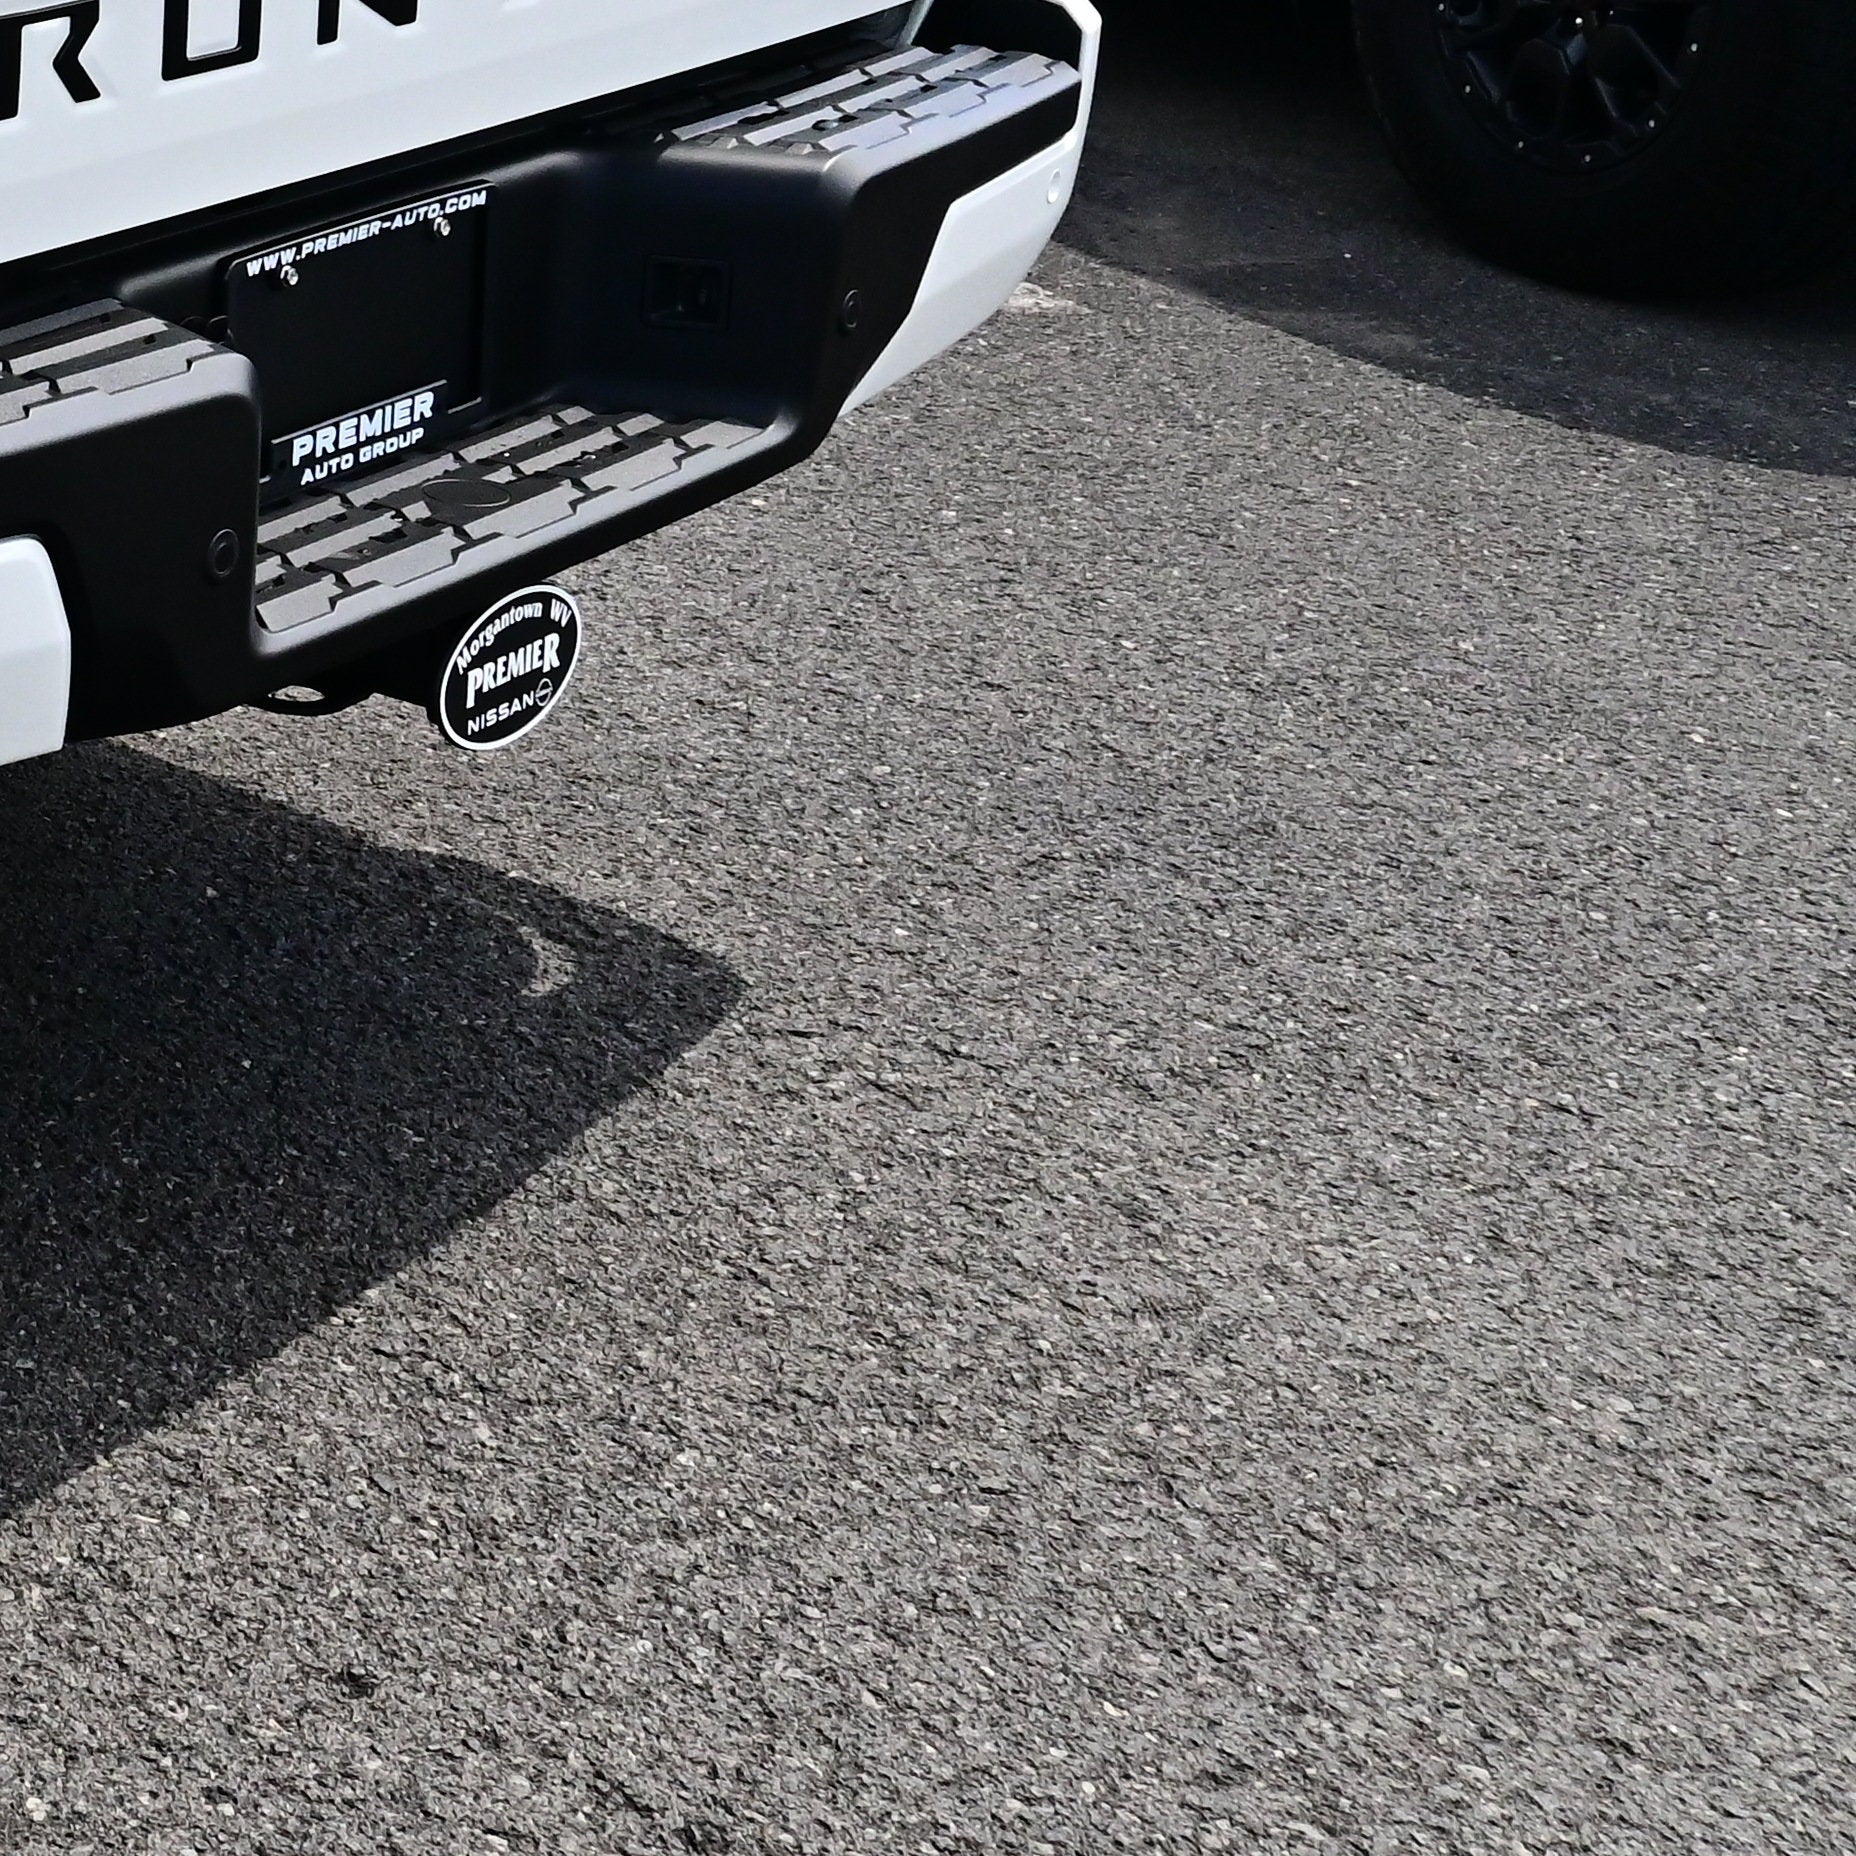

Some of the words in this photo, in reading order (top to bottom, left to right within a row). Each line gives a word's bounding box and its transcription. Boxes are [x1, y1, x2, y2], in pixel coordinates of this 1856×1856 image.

[246, 190, 487, 277] WWW.PREMIER-AUTO.COM
[291, 391, 435, 467] PREMIER
[300, 453, 352, 486] AUTO
[359, 427, 424, 463] GROUP
[456, 602, 543, 675] Morgantown
[550, 598, 572, 628] WV
[466, 633, 561, 709] PREMIER
[467, 690, 535, 736] NISSAN
